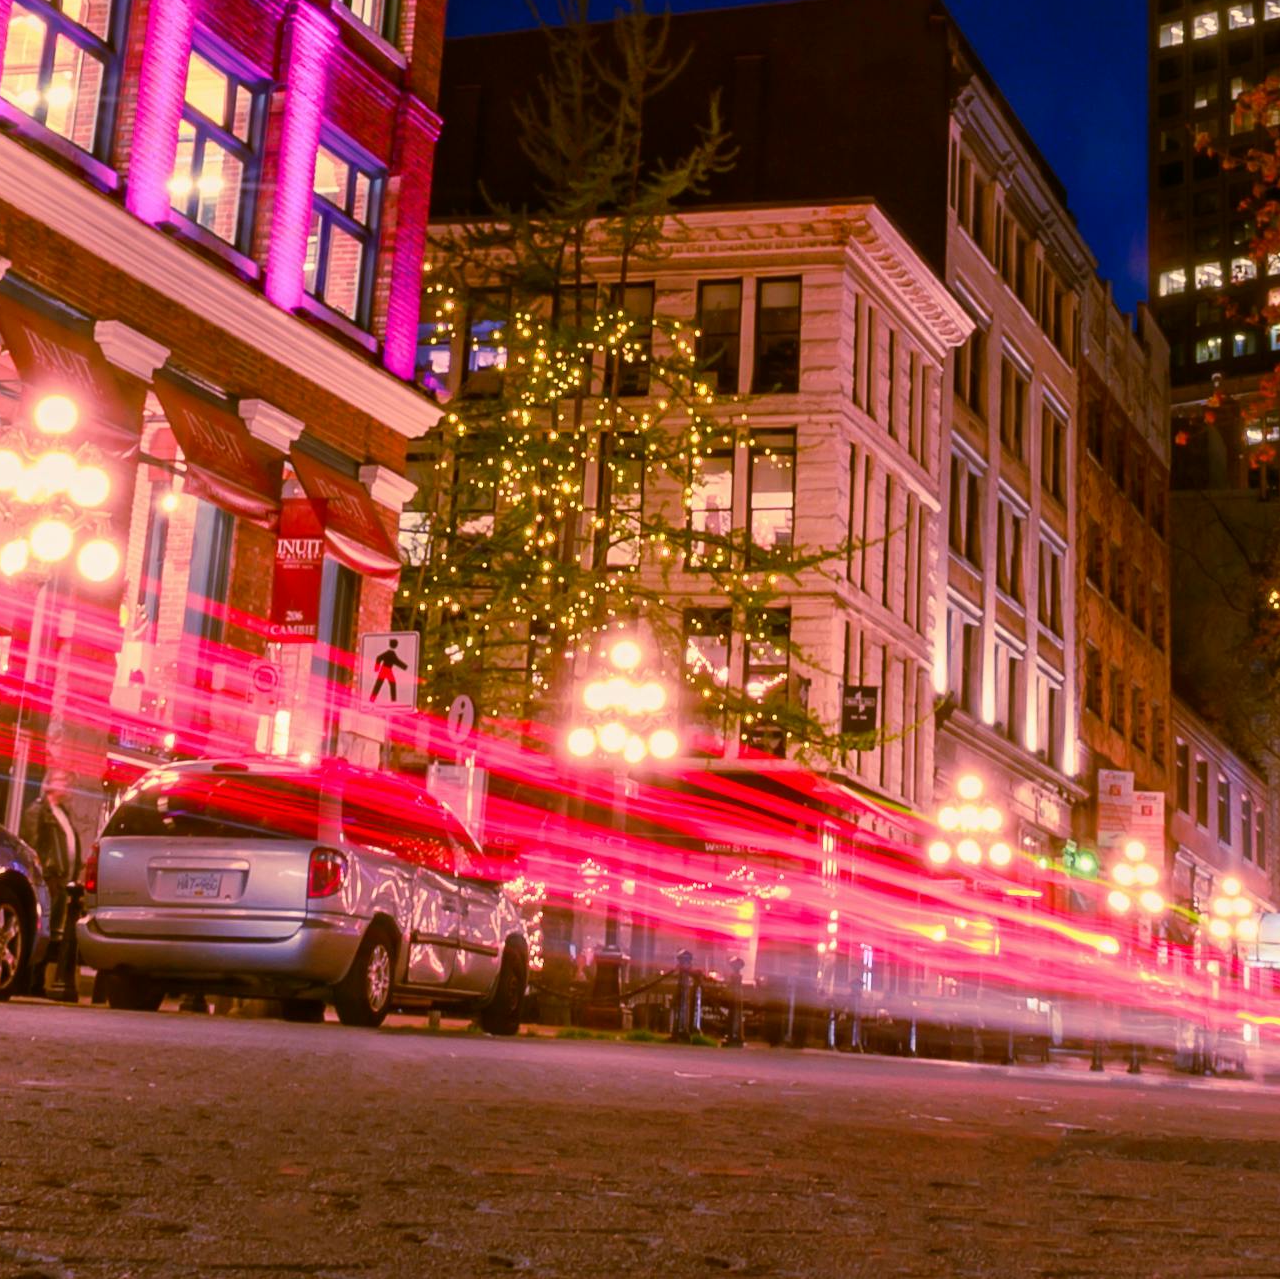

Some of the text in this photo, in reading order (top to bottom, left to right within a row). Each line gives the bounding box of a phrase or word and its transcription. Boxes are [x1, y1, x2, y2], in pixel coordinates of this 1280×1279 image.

[21, 323, 95, 385] INUIT
[182, 409, 243, 464] INUIT
[276, 538, 323, 555] INUIT
[285, 610, 304, 622] 206
[270, 624, 316, 636] CAMBIE
